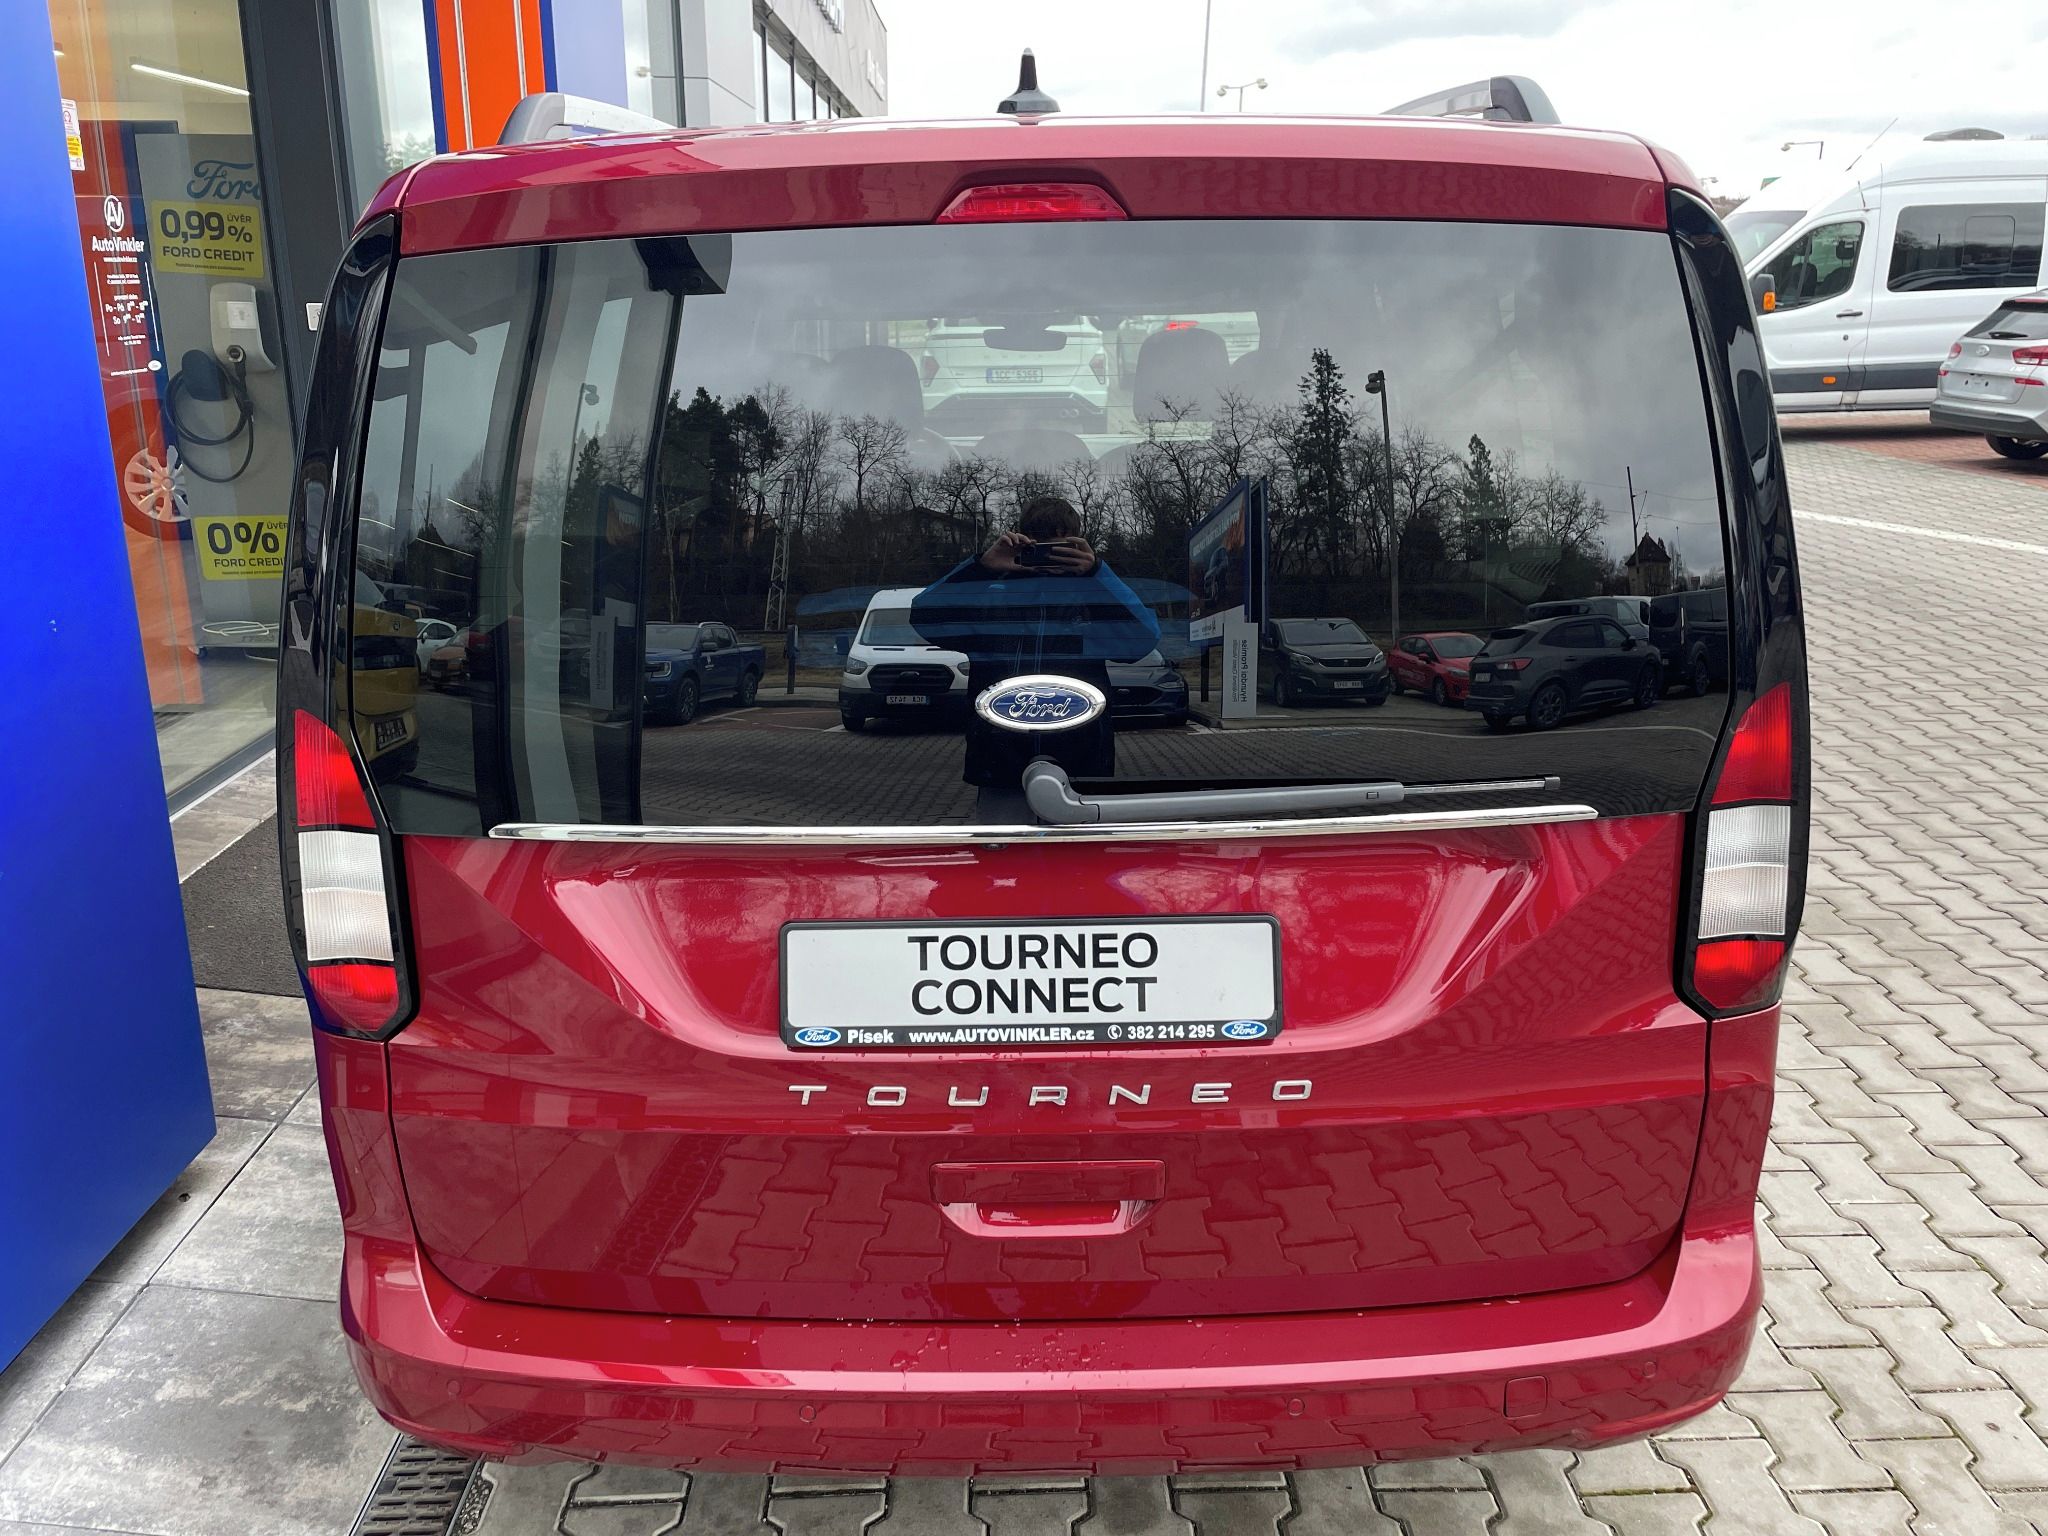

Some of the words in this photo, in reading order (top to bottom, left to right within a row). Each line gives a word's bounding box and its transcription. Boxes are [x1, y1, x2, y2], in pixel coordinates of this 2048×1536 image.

[160, 208, 225, 243] 0,99
[227, 225, 253, 243] %
[91, 235, 145, 252] AutoVinkler
[162, 246, 201, 258] FORD
[203, 248, 255, 262] CREDIT
[207, 521, 280, 555] 0%
[214, 558, 246, 568] FORD
[248, 557, 285, 567] CREDI
[1009, 691, 1071, 718] Ford
[907, 932, 1159, 971] TOURNEO
[911, 976, 1158, 1015] CONNECT
[847, 1029, 894, 1044] Písek
[909, 1026, 1095, 1043] www.AUTOVINKLER.cz
[1128, 1025, 1154, 1039] 382
[1158, 1025, 1184, 1039] 214
[1188, 1025, 1215, 1038] 295
[788, 1079, 1313, 1107] TOURNEO
